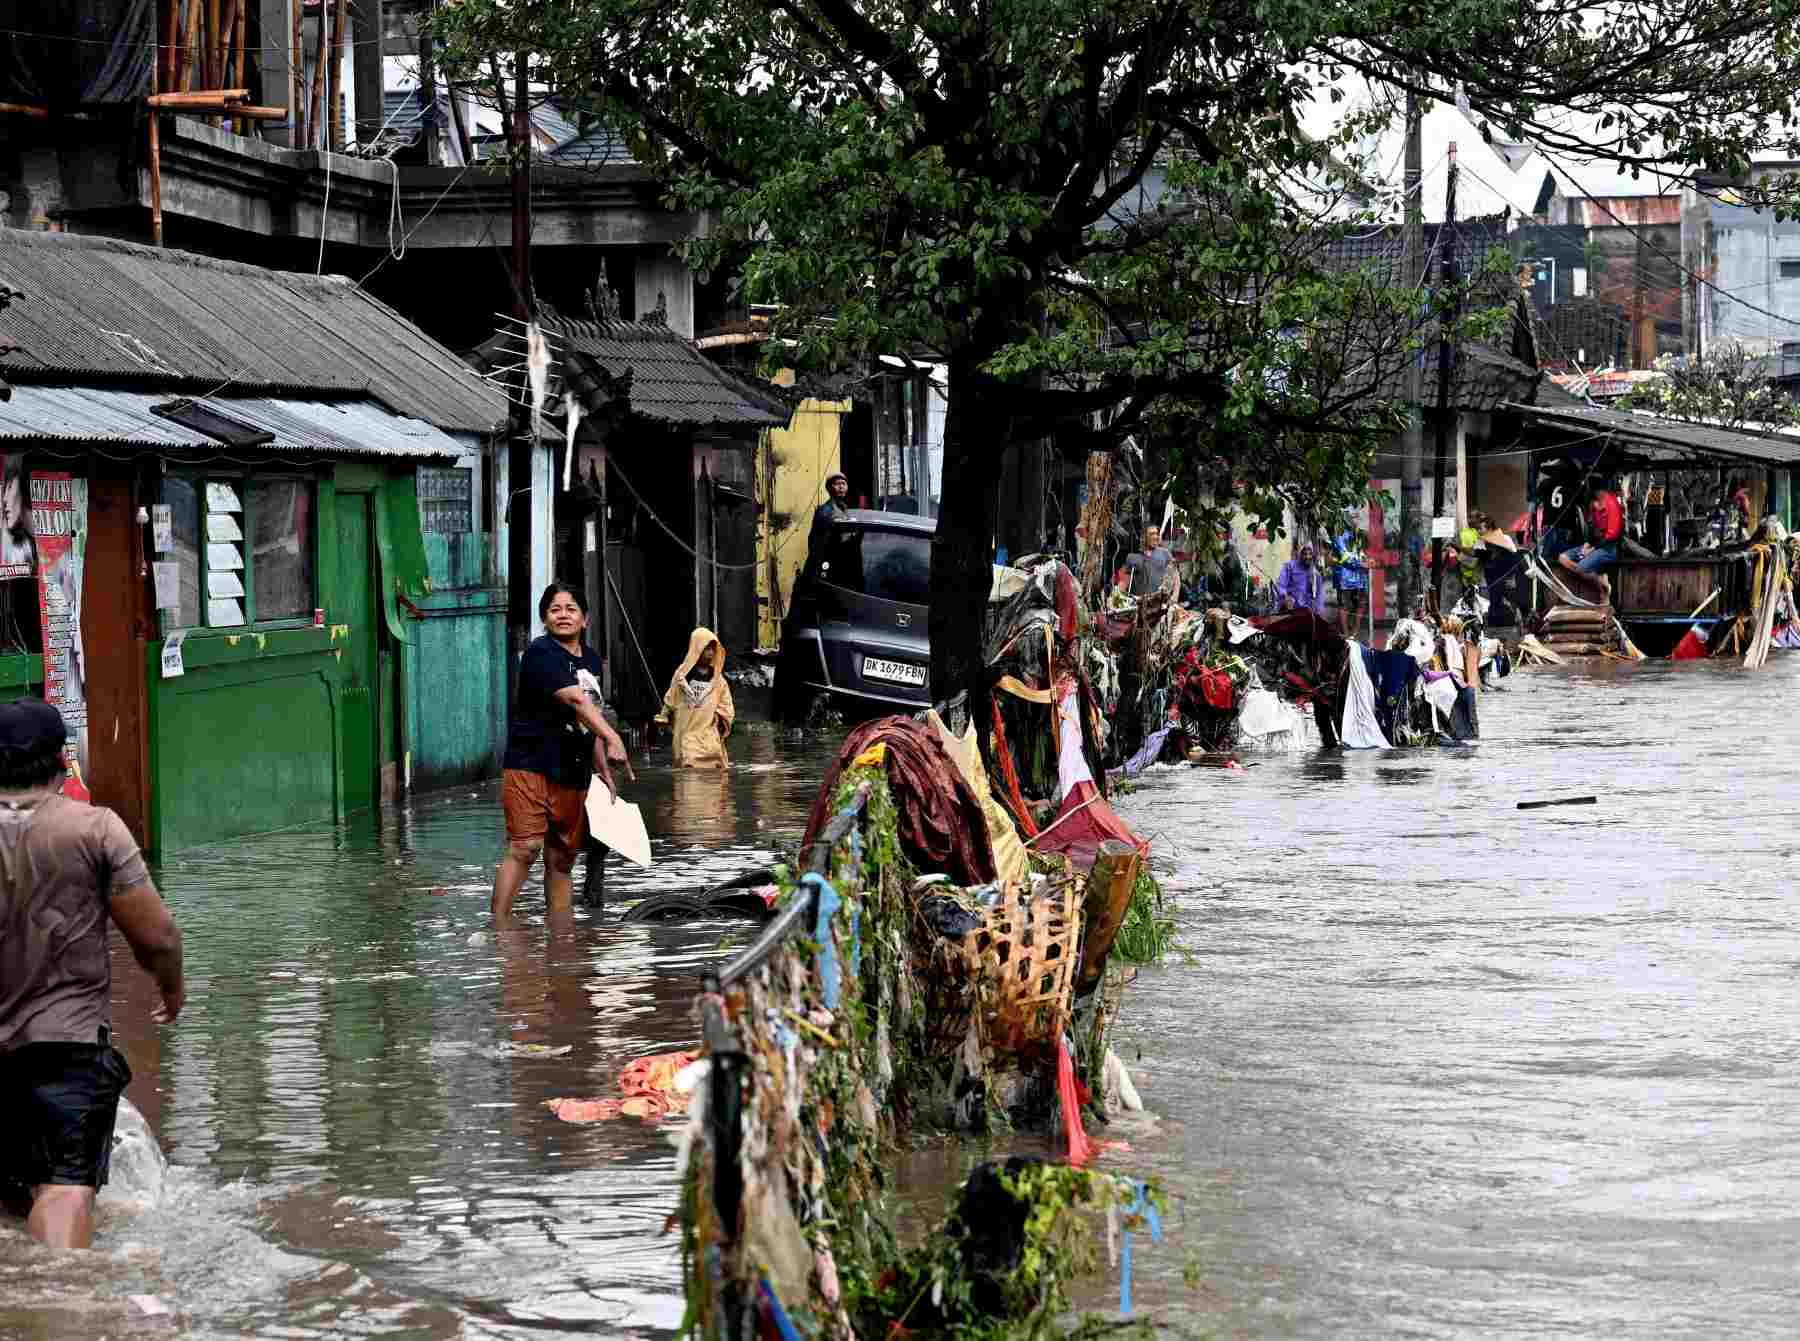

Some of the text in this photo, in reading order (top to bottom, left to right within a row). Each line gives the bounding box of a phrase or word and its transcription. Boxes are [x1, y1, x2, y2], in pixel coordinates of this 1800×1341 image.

[1551, 485, 1563, 508] 6
[866, 659, 879, 671] DK
[880, 662, 904, 675] 1679
[905, 667, 925, 680] FBN
